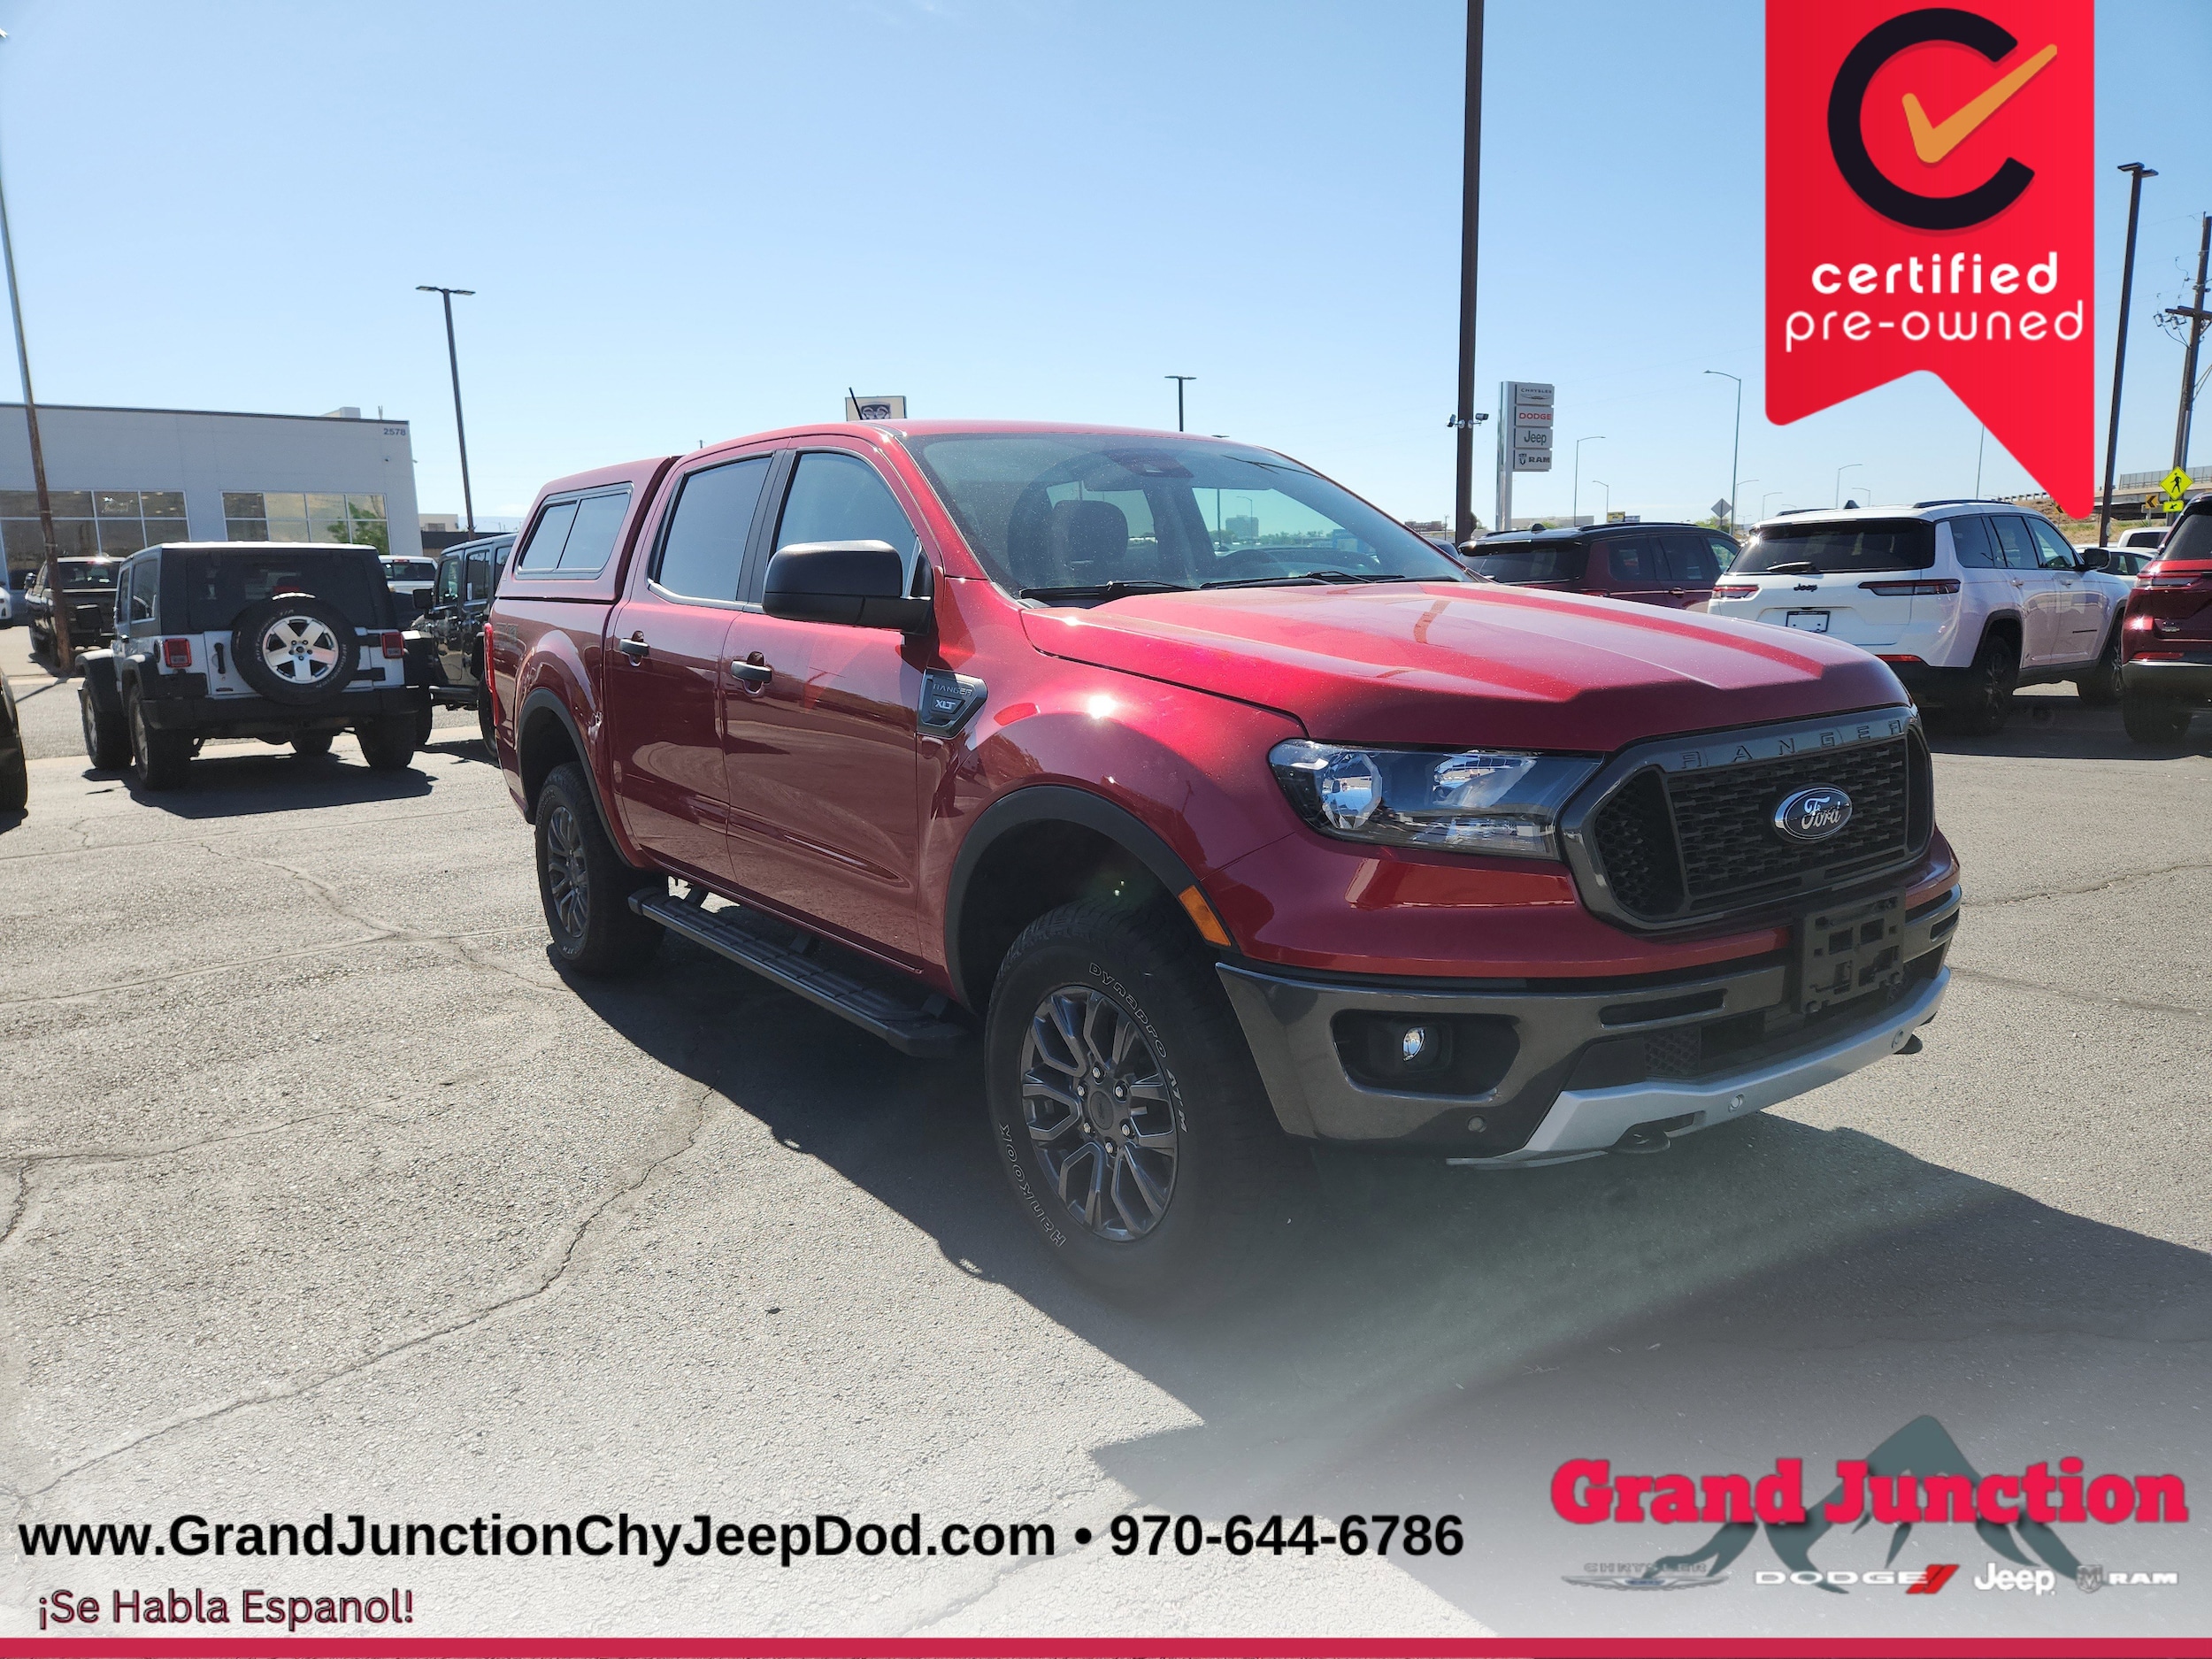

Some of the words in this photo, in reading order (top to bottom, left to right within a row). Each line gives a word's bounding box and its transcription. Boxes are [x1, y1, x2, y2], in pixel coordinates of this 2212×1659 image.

[383, 427, 406, 436] 2578
[1524, 430, 1547, 445] Jeep
[933, 684, 973, 695] RANGER
[934, 699, 956, 710] XLT
[1679, 719, 1903, 770] RANGER
[1801, 795, 1842, 830] Ford
